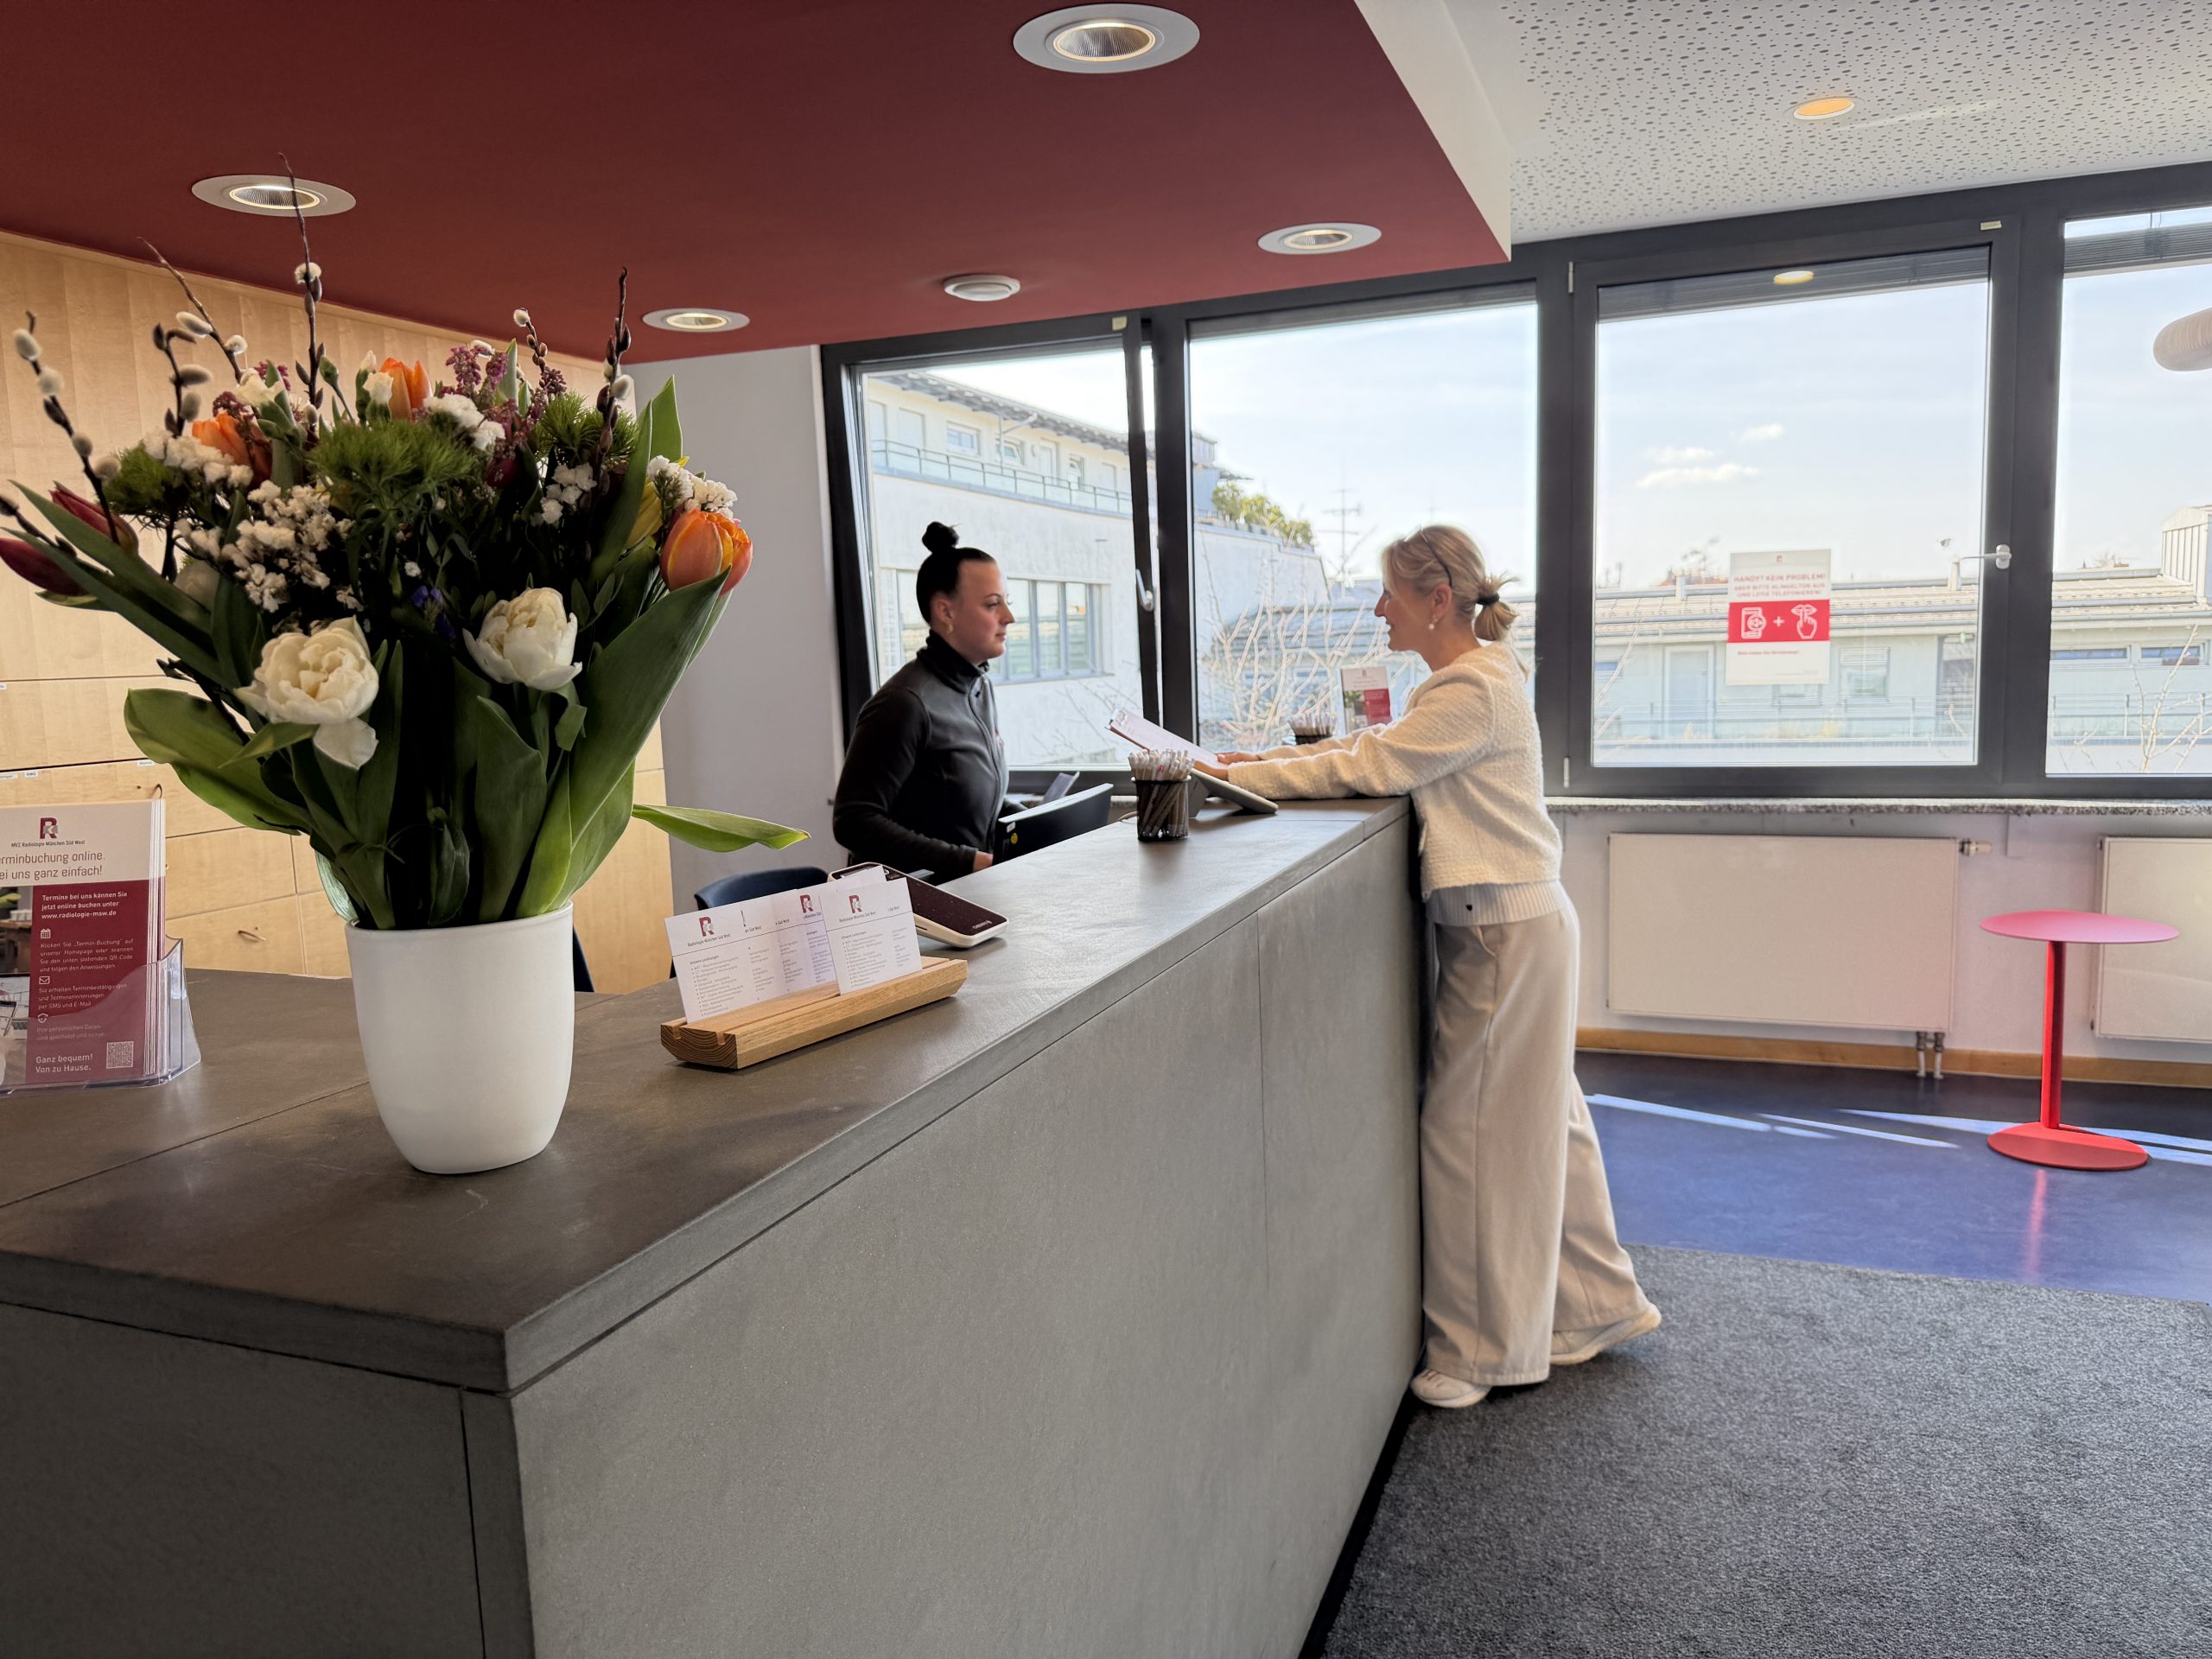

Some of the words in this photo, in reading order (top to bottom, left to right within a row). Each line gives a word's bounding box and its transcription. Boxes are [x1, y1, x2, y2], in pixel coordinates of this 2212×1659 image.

[0, 852, 69, 865] rminbuchung
[11, 871, 30, 880] uns
[35, 870, 59, 880] ganz
[61, 865, 103, 877] einfach!
[41, 910, 117, 919] www.radiologie-msw.de
[58, 1053, 93, 1063] bequem!
